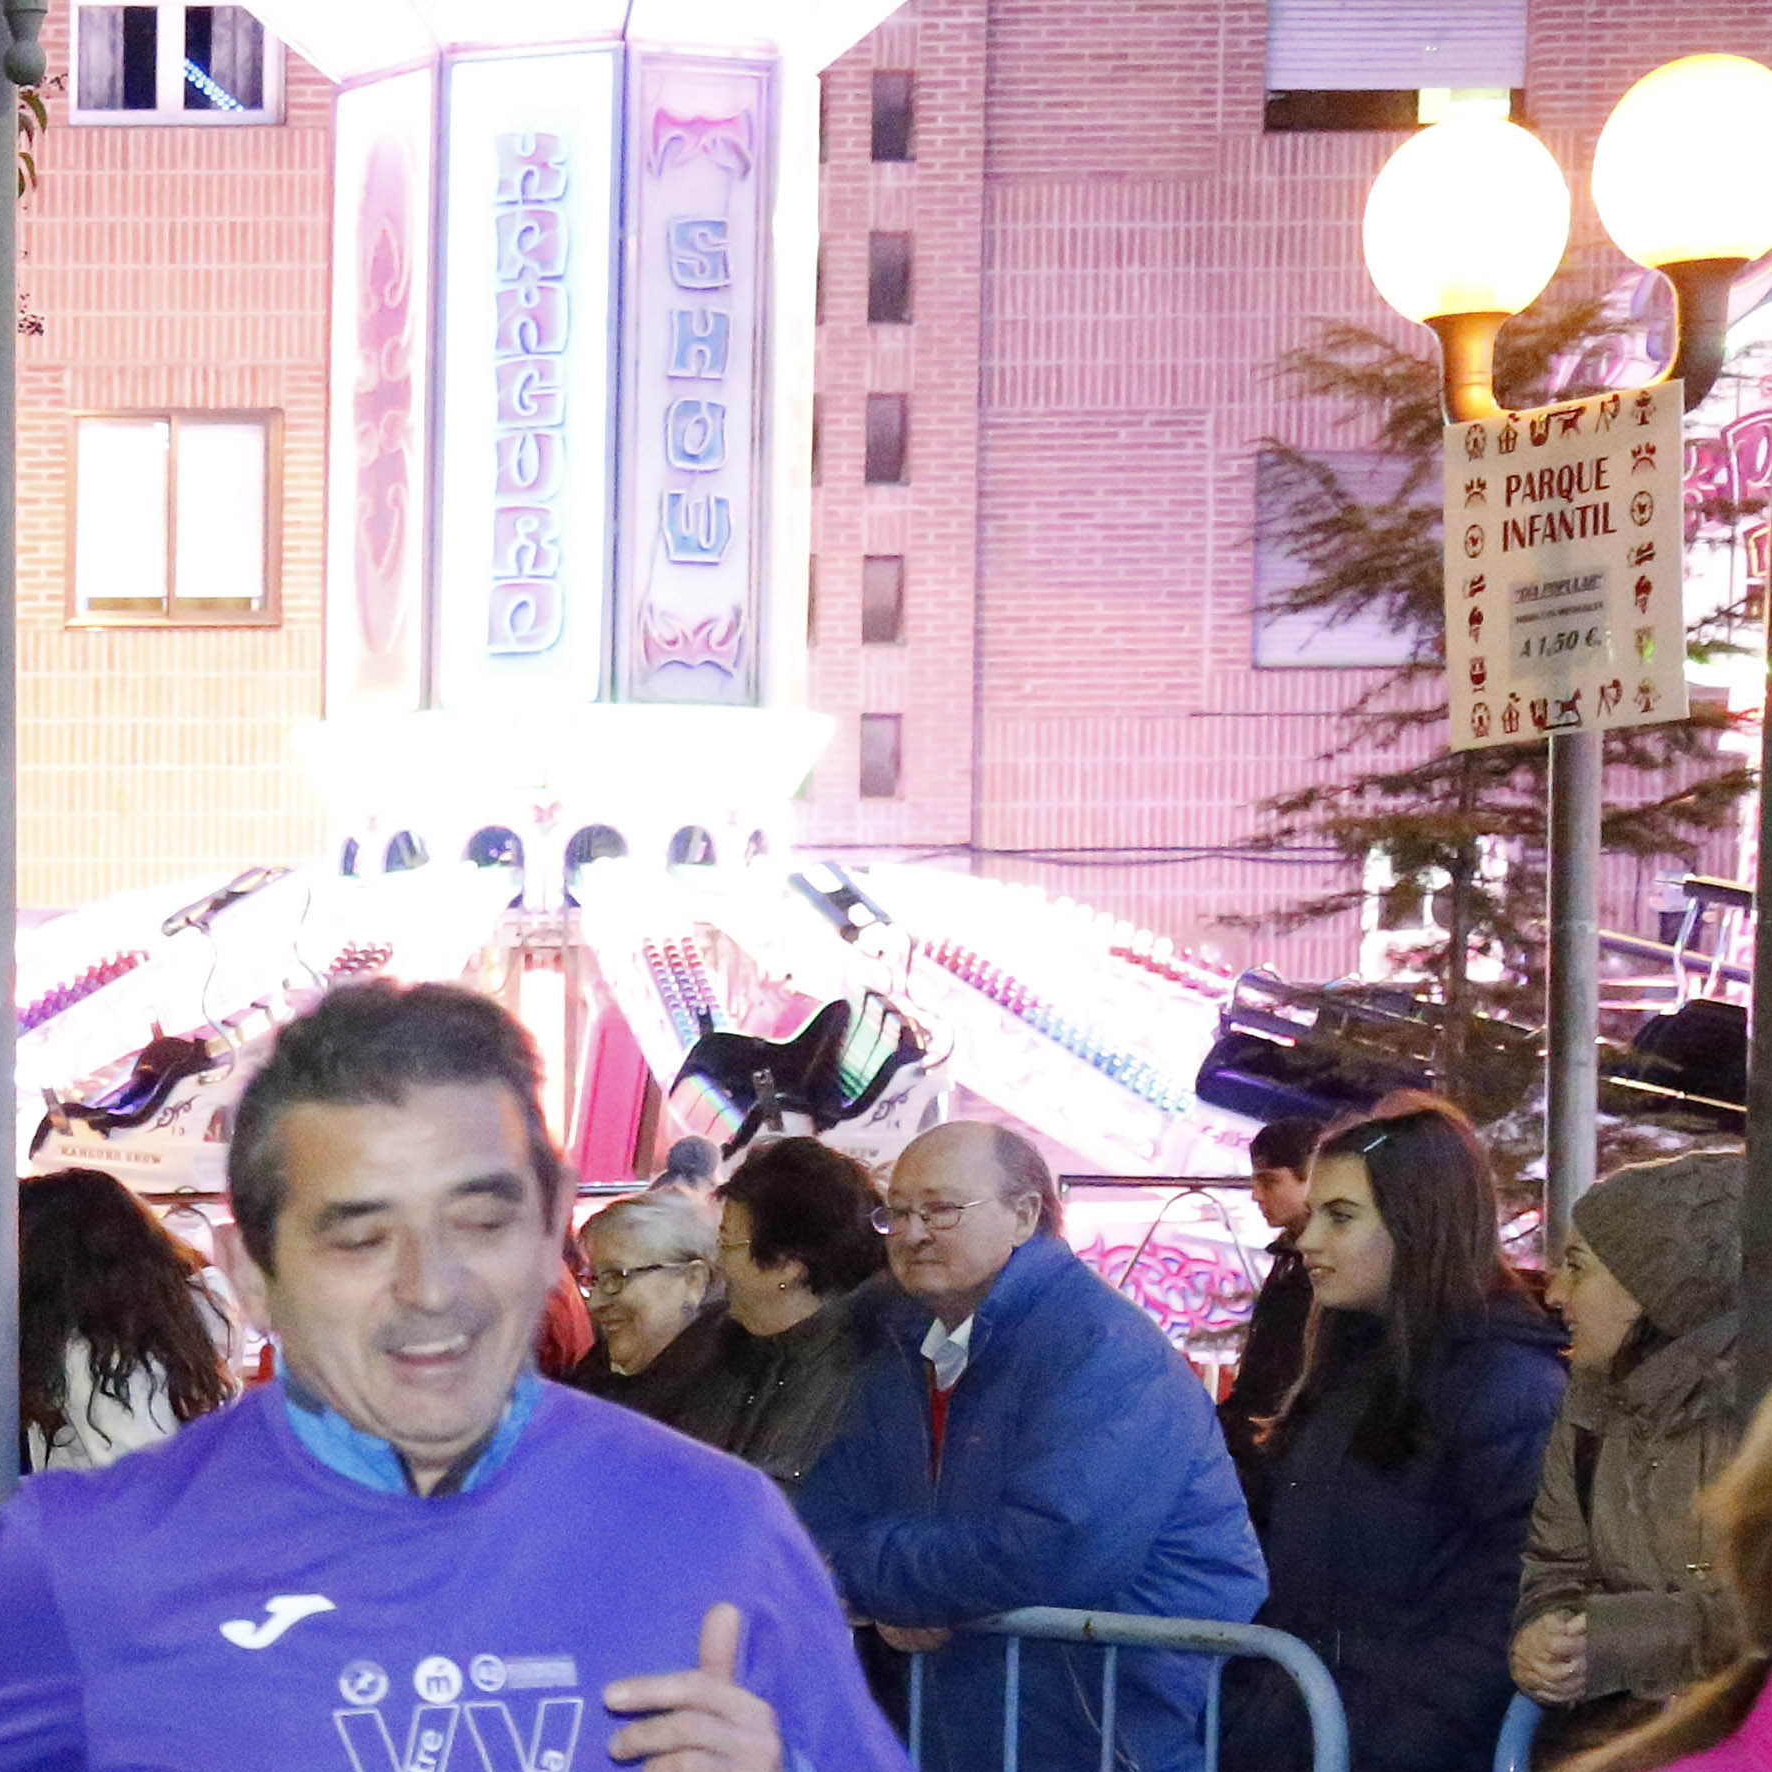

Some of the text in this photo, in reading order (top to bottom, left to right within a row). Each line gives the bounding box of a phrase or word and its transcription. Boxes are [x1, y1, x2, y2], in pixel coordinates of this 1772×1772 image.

[661, 216, 735, 564] SHOW
[1504, 456, 1611, 508] PARQUE
[1501, 500, 1618, 553] INFANTIL
